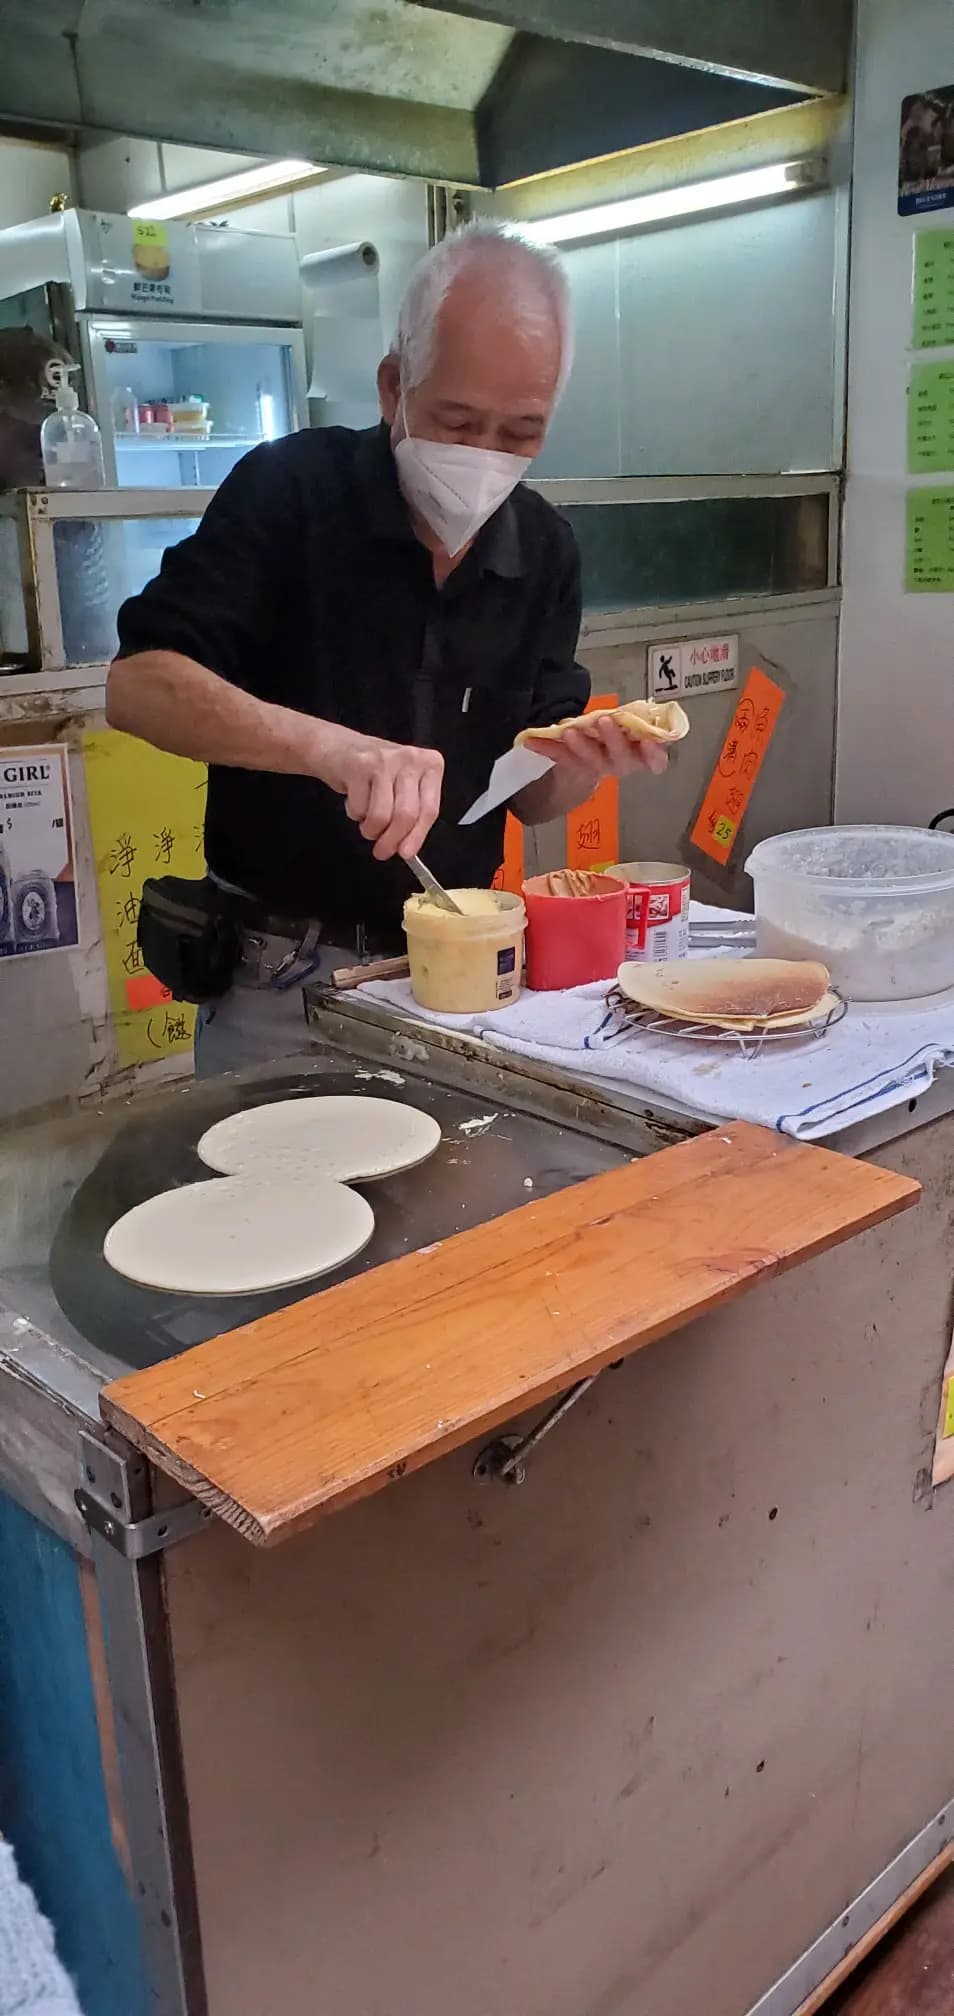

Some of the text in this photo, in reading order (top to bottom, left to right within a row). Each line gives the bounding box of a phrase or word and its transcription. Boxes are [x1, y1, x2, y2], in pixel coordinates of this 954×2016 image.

[684, 668, 735, 688] CAUTION SLIPPERY FLOOR
[4, 765, 50, 783] GIRL
[715, 822, 732, 840] 25
